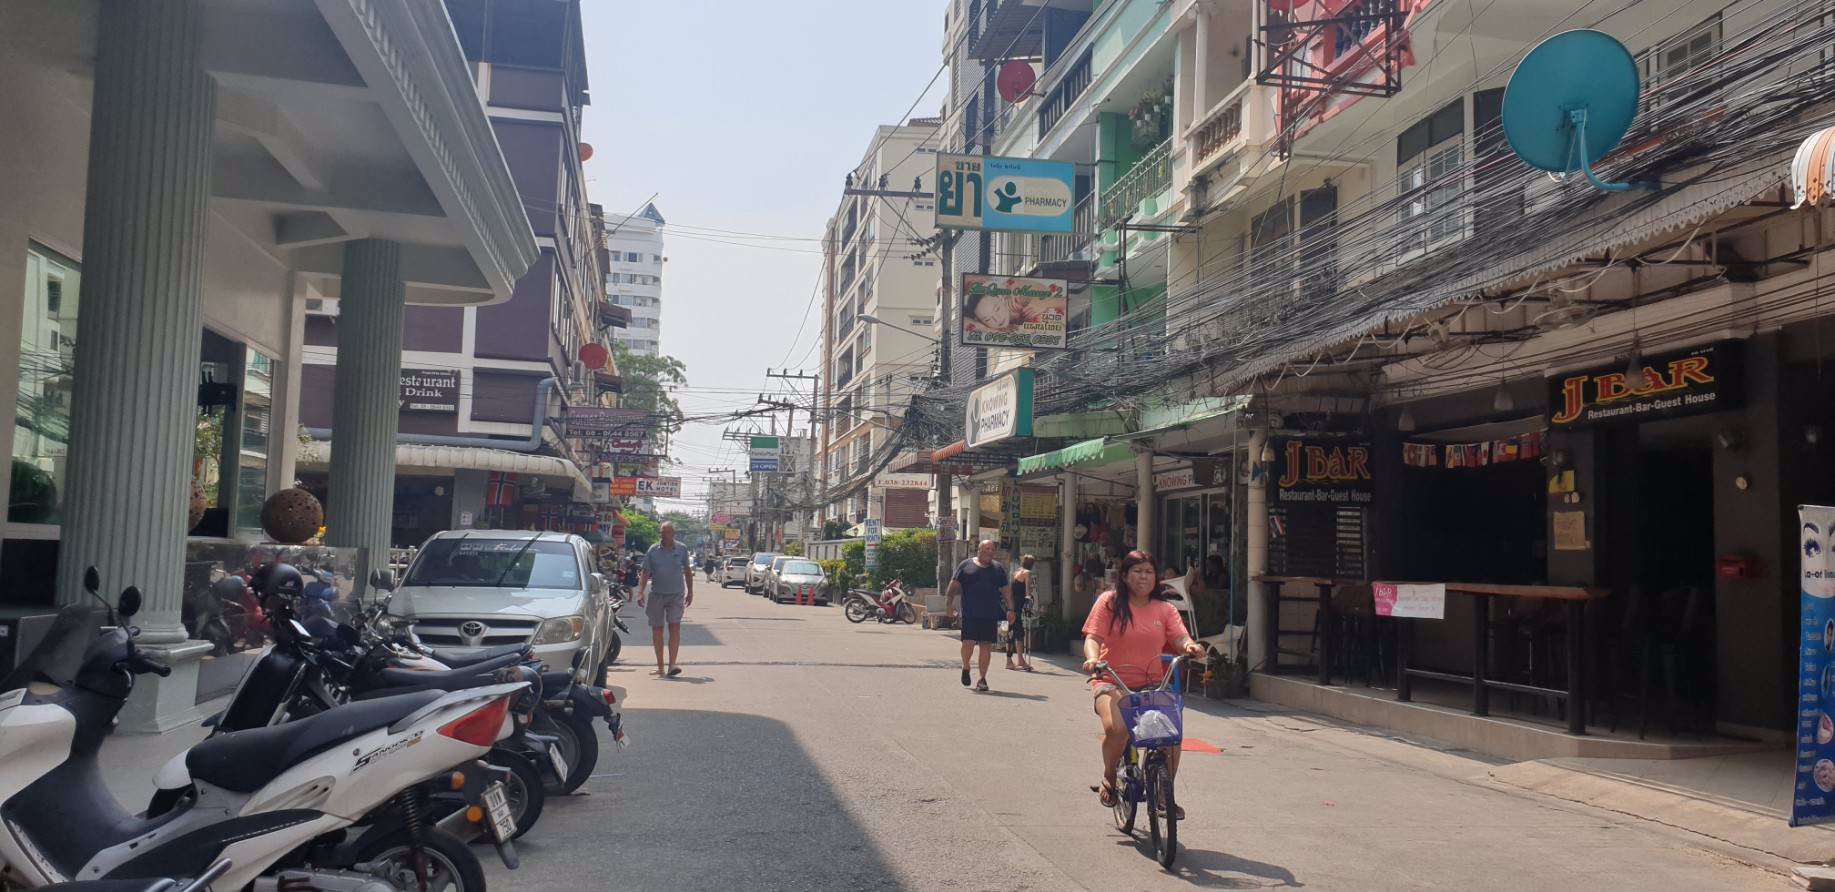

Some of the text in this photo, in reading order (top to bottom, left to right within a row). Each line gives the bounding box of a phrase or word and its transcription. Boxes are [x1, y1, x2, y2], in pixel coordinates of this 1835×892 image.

[955, 161, 981, 172] ขาย
[939, 170, 982, 217] ยา
[1025, 197, 1067, 208] PHARMACY
[1055, 287, 1063, 298] 2
[400, 376, 456, 388] estaurant
[405, 387, 443, 398] Drink
[982, 391, 1009, 413] KNOWING
[1552, 376, 1588, 423] J
[1588, 391, 1716, 420] Restaurant-Bar-Guest House
[980, 410, 1010, 433] PHARMACY
[1279, 441, 1302, 488] J
[638, 481, 653, 491] EK
[1280, 489, 1372, 502] Restaurant-Bar-Guest House
